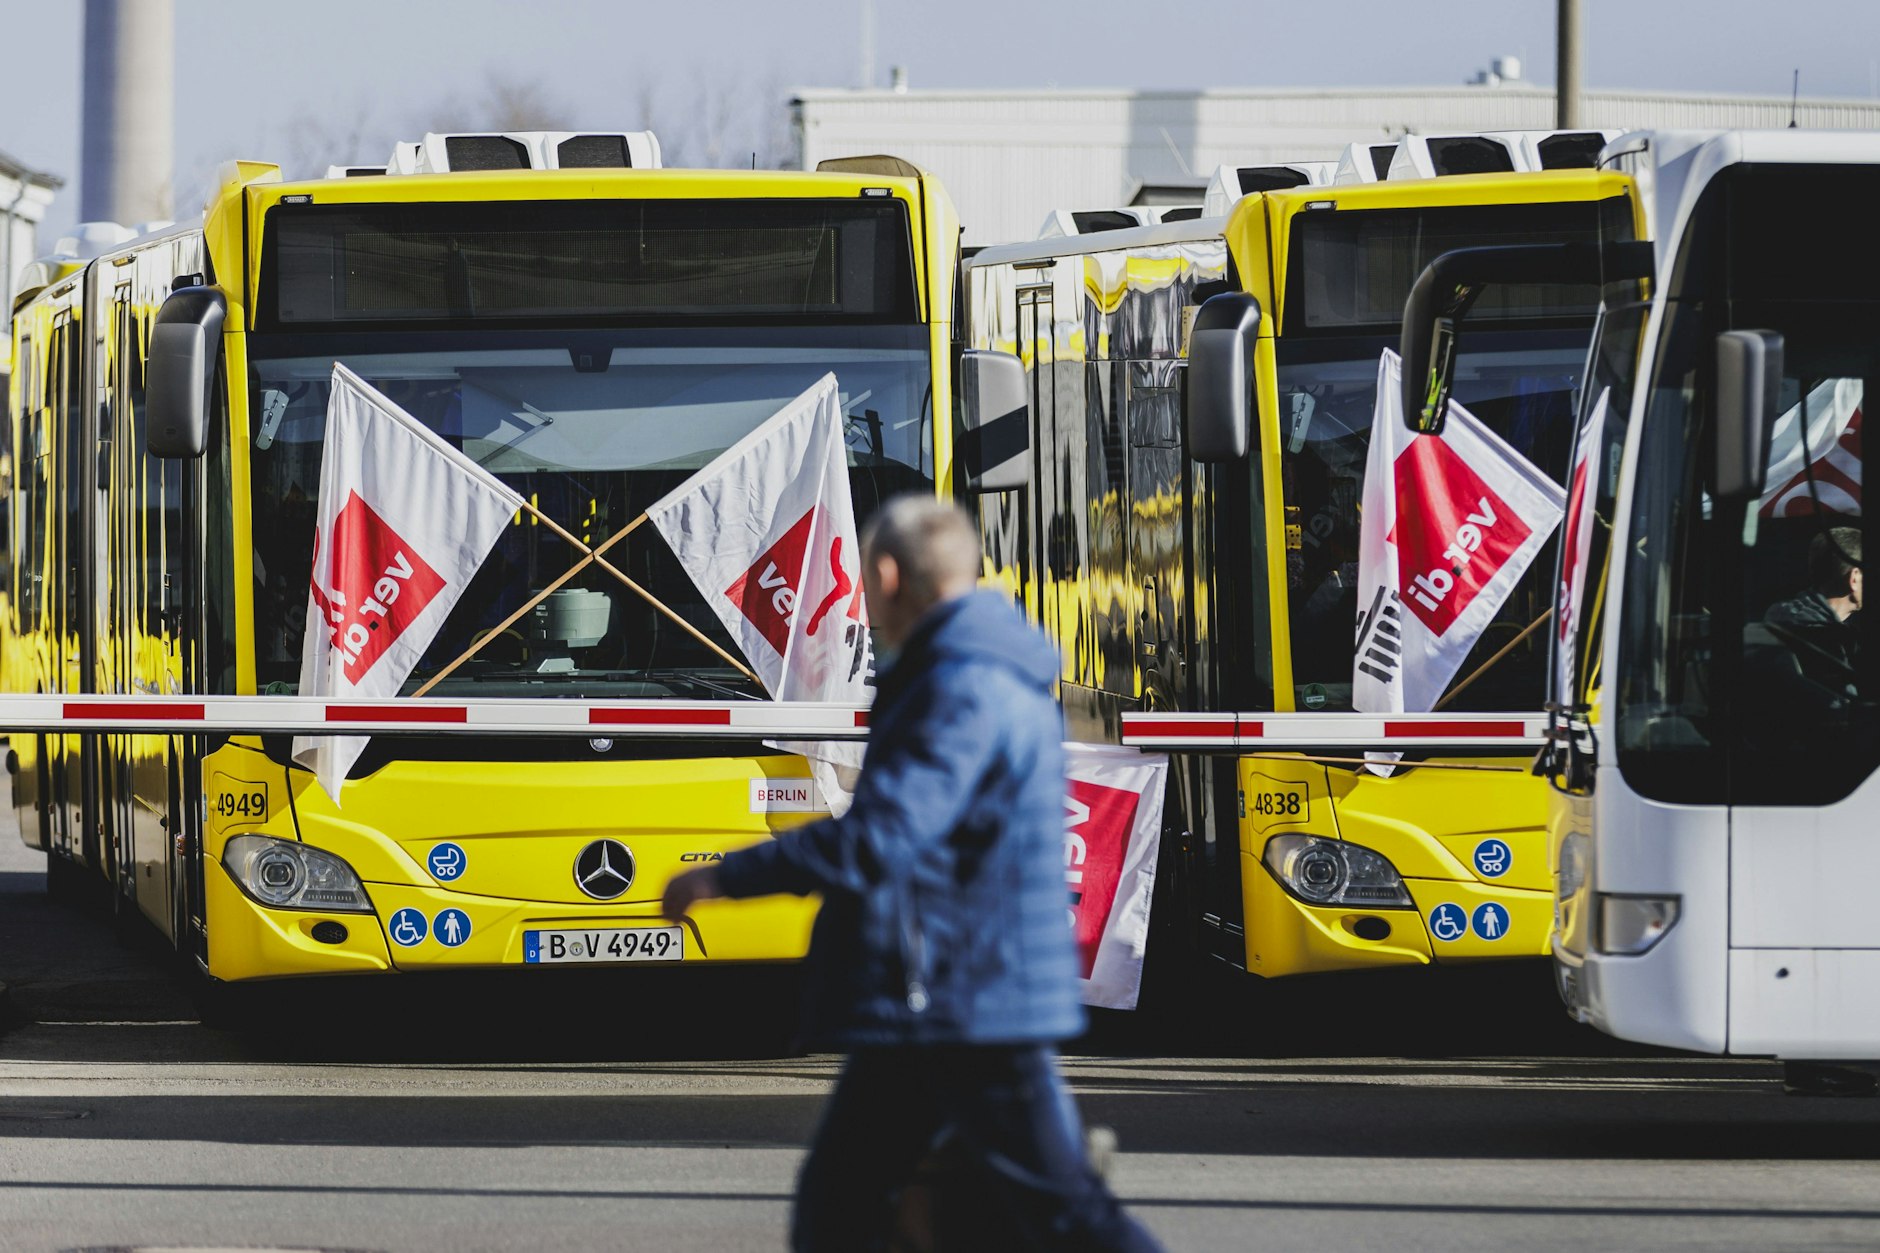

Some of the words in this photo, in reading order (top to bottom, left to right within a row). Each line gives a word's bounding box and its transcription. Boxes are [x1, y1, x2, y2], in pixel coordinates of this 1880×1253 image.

[757, 560, 797, 627] ve
[217, 792, 265, 817] 4949
[757, 789, 807, 801] BERLIN
[1255, 792, 1301, 815] 4838
[680, 852, 727, 862] CITA
[550, 934, 566, 959] B
[584, 933, 600, 958] V
[607, 932, 671, 957] 4949
